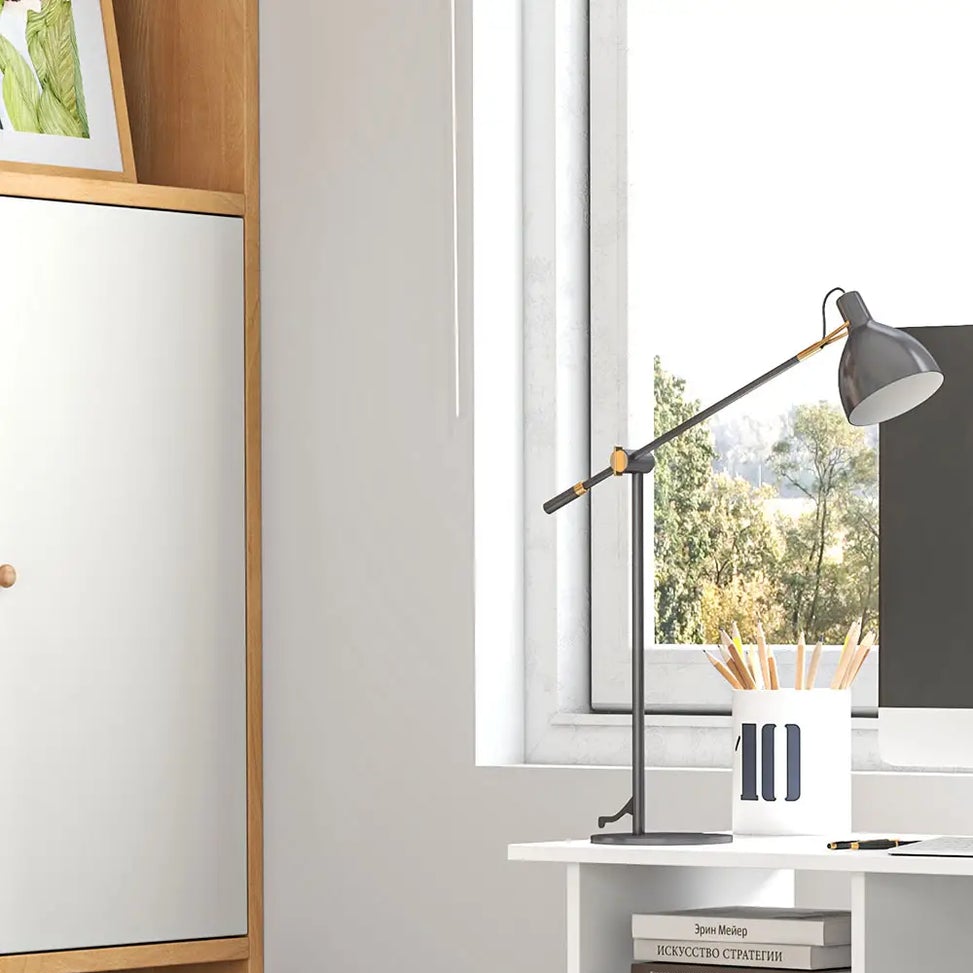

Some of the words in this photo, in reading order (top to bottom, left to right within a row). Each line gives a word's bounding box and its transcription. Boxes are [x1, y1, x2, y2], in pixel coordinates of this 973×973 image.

[695, 923, 716, 937] Эрин
[718, 924, 748, 938] Мейер
[656, 944, 720, 959] ИСКУССТВО
[722, 947, 783, 963] СТРАТЕГИИ
